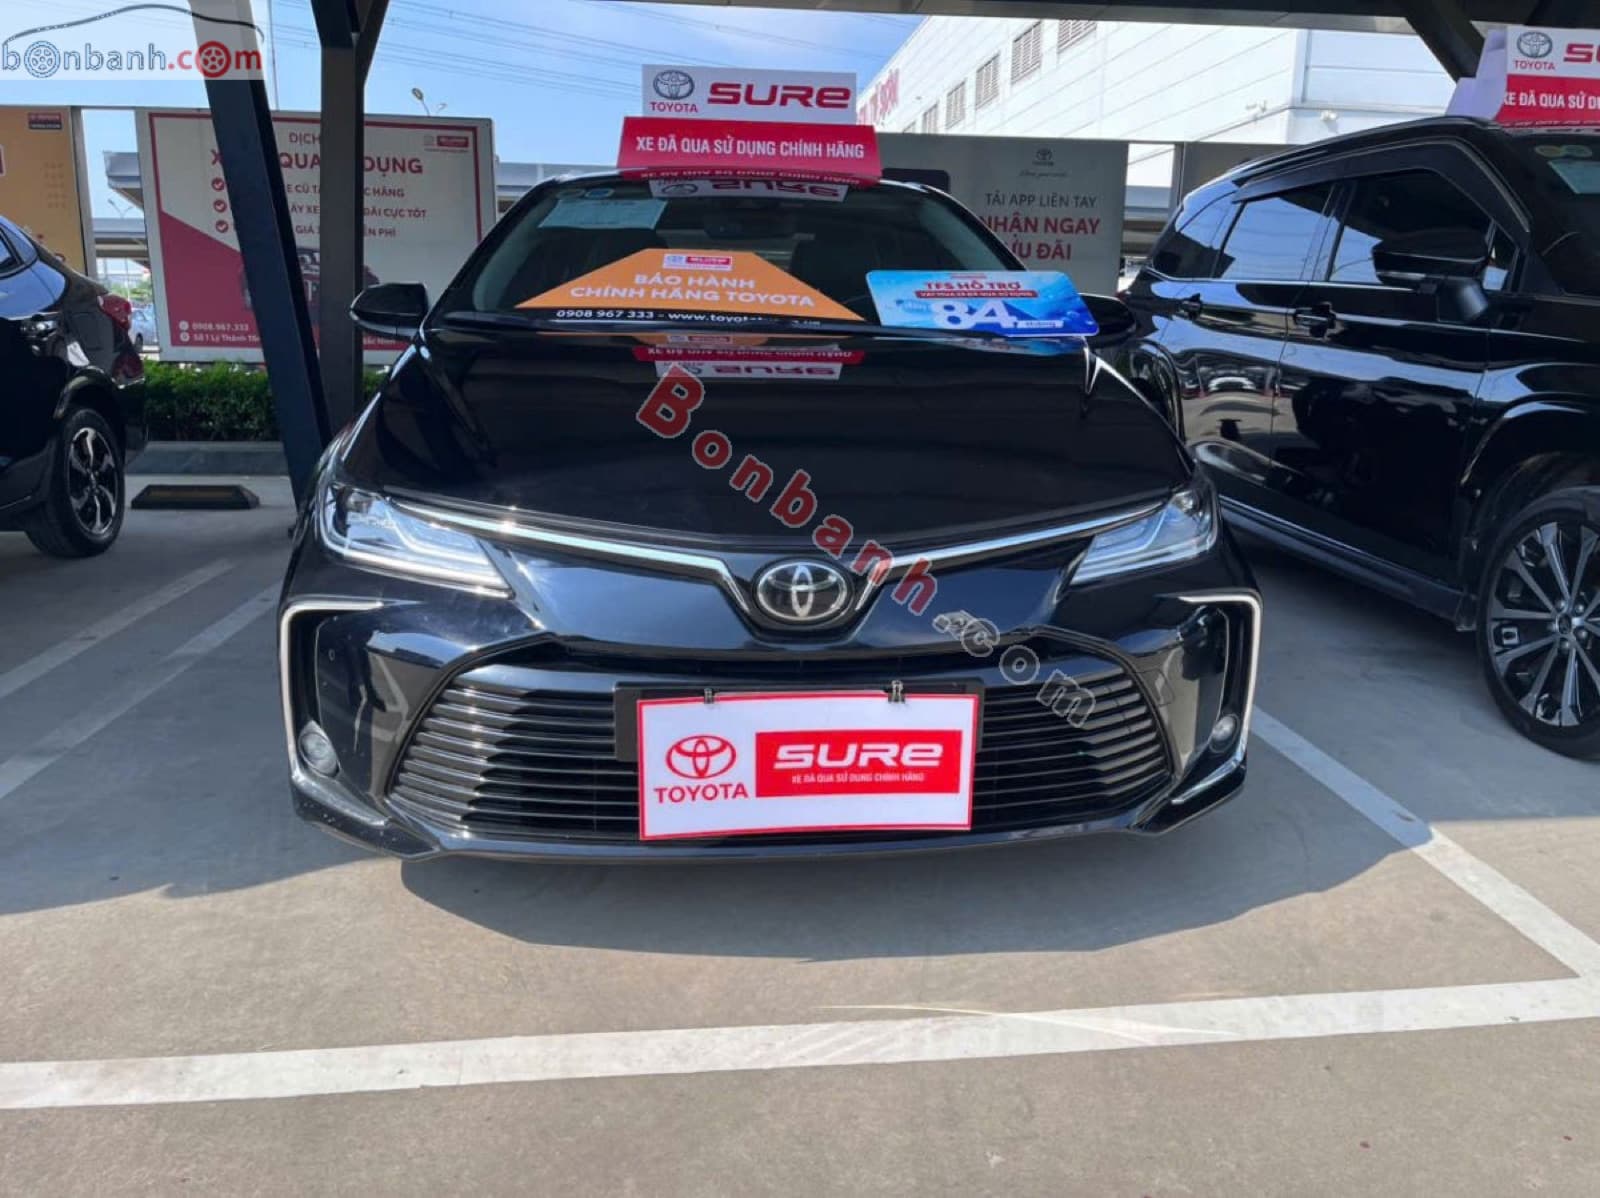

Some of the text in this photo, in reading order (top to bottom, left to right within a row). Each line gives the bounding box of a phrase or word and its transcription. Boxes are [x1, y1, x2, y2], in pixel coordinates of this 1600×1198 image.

[1514, 60, 1556, 71] TOYOTA
[651, 102, 698, 113] TOYOTA
[1539, 93, 1565, 108] QUA
[1568, 91, 1586, 109] SỬ
[636, 135, 865, 159] XE ĐÃ QUA SỬ DỤNG CHÍNH HÃNG
[279, 152, 321, 169] QUA
[1009, 193, 1036, 206] APP
[1072, 196, 1097, 208] TAY
[1044, 216, 1100, 235] NGAY
[1036, 239, 1072, 260] ĐÃI
[570, 285, 644, 298] CHÍNH
[726, 292, 815, 307] TOYOTA
[556, 309, 593, 318] 0908
[596, 310, 624, 319] 967
[626, 311, 654, 319] 333
[930, 300, 1017, 330] 84
[654, 783, 748, 804] TOYOTA
